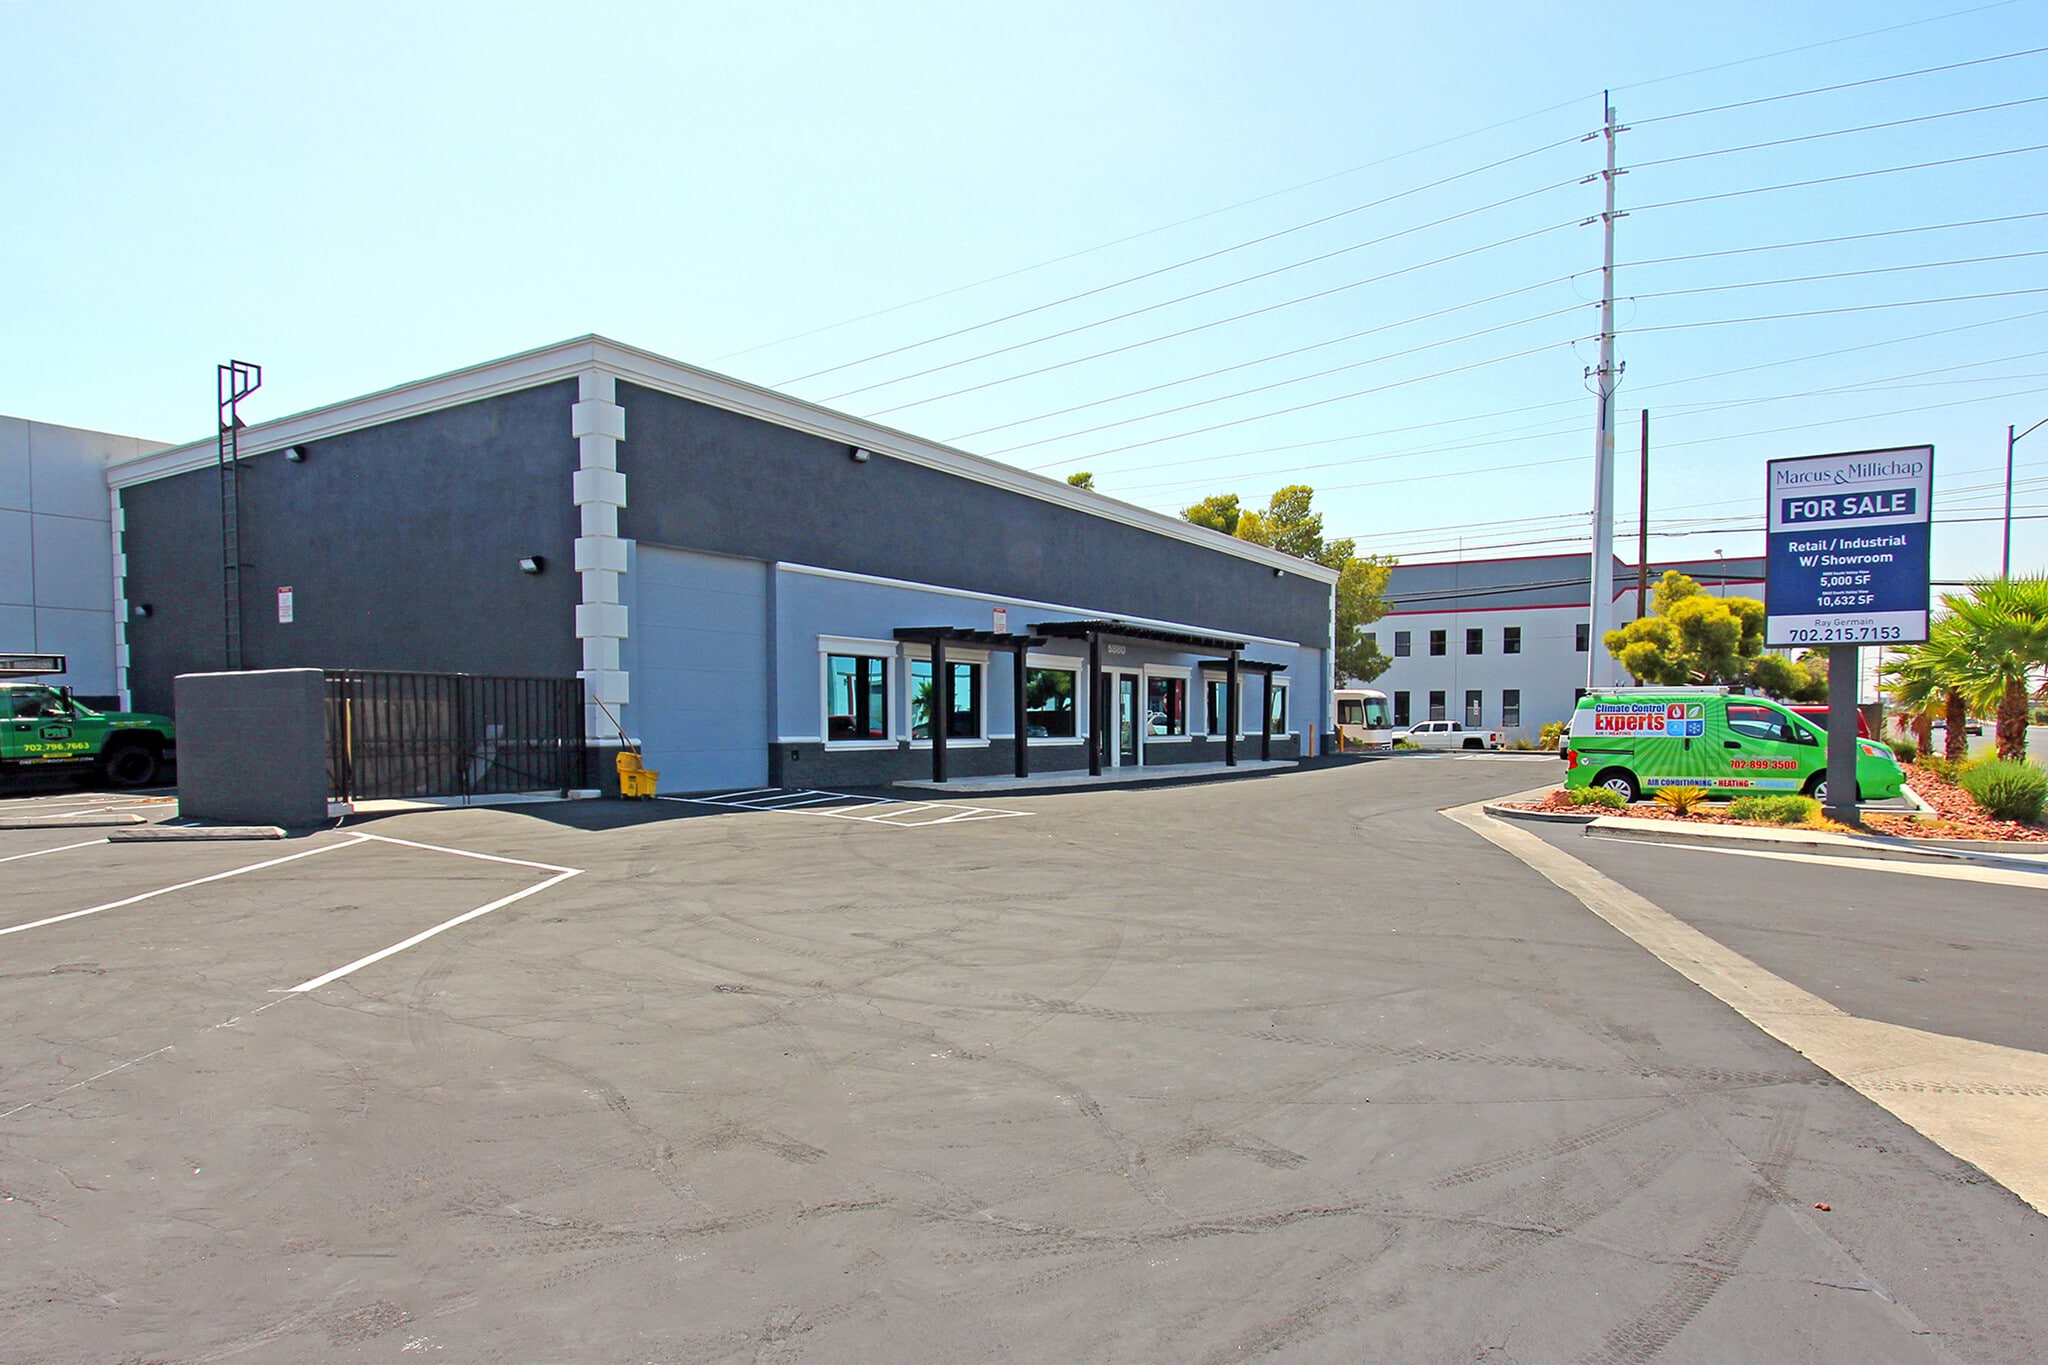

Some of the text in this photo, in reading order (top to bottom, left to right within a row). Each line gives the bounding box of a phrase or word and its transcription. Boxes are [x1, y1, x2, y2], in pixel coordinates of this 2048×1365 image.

[1777, 461, 1923, 485] Marcus & Millichap
[1790, 493, 1907, 519] FOR SALE
[1788, 540, 1828, 552] Retail
[1840, 535, 1907, 549] Industrial
[1800, 553, 1893, 567] W/ Showroom
[1820, 574, 1871, 587] 5,000 SF
[1817, 594, 1875, 607] 10,632 SF
[1814, 618, 1874, 627] Ray Germain
[1789, 626, 1901, 641] 702.215.7153
[1595, 704, 1665, 713] Climate Control
[1595, 713, 1665, 731] Experts
[1730, 759, 1797, 770] 702-899-3500
[1660, 779, 1712, 787] CONDITIONING
[1718, 780, 1749, 788] HEATING
